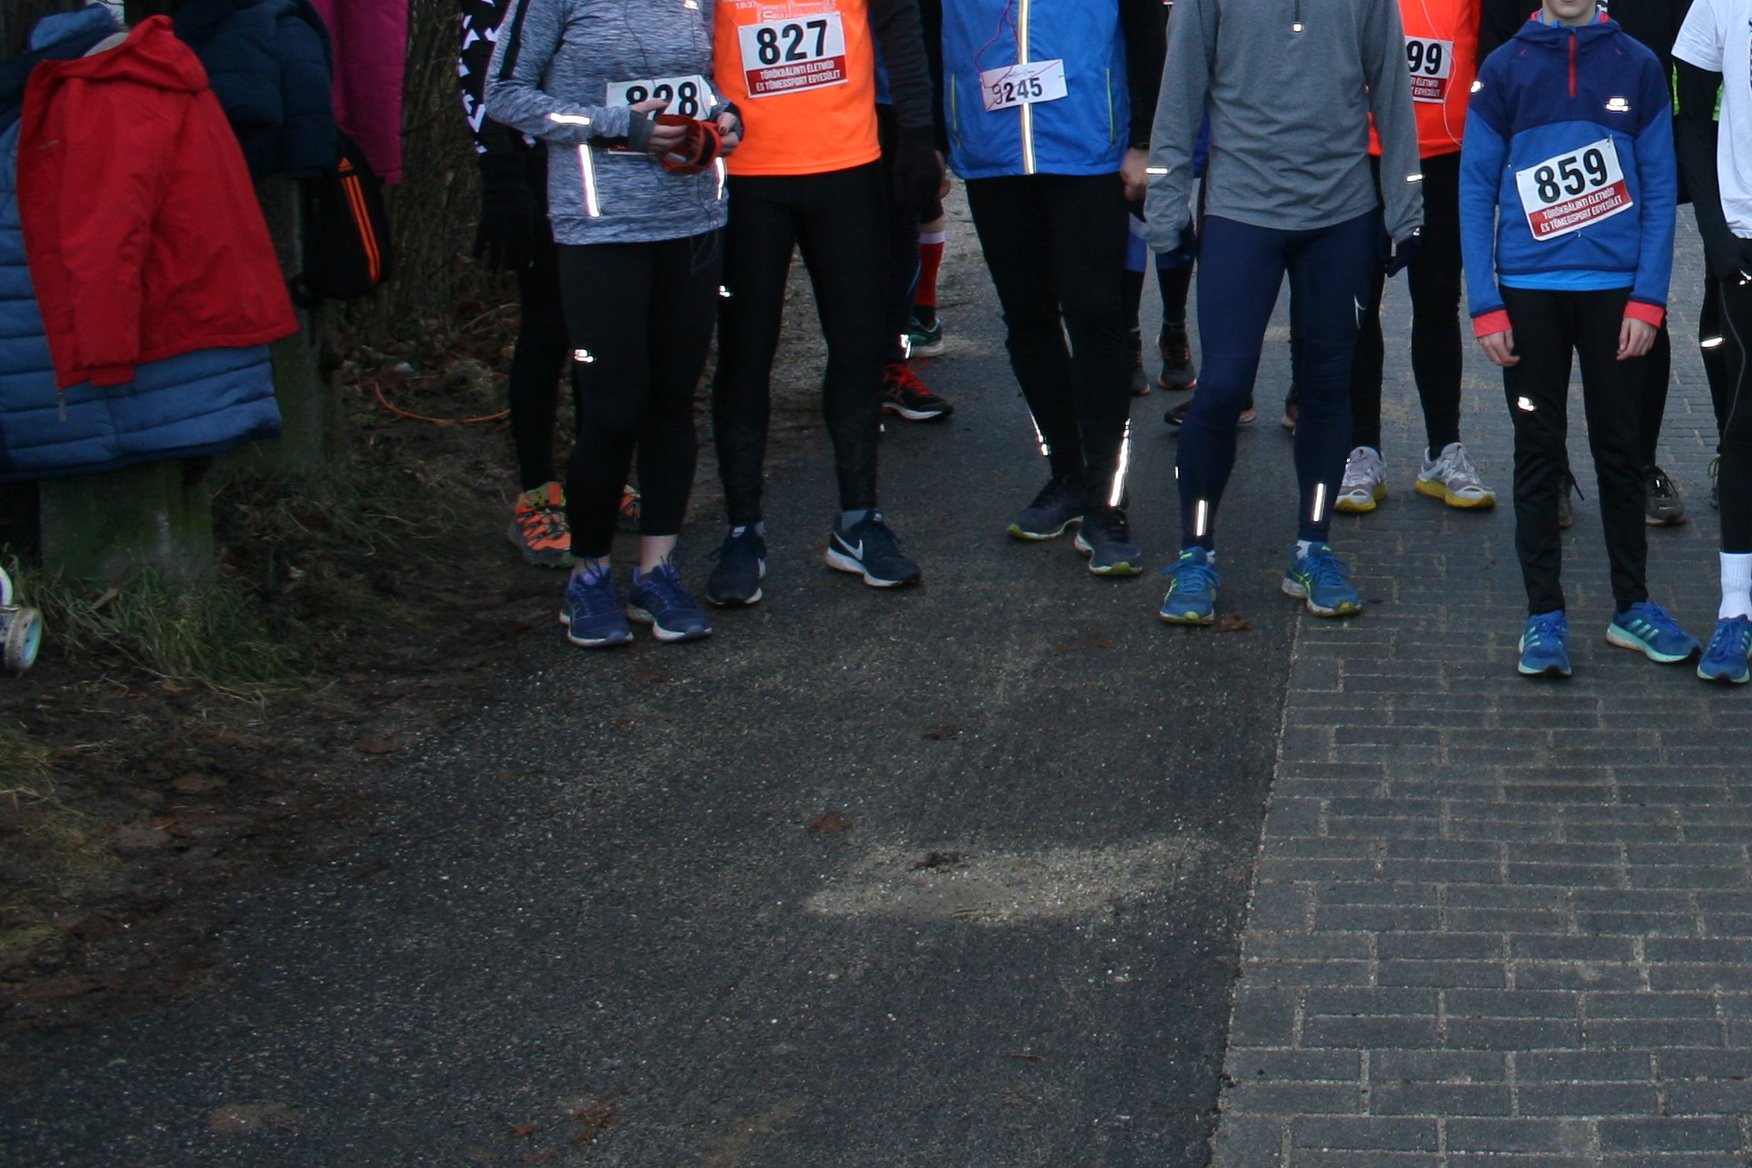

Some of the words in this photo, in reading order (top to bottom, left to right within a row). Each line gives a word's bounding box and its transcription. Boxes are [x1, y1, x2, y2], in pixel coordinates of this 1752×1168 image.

[757, 19, 827, 65] 827
[992, 77, 1042, 105] 9245
[1534, 148, 1608, 203] 859
